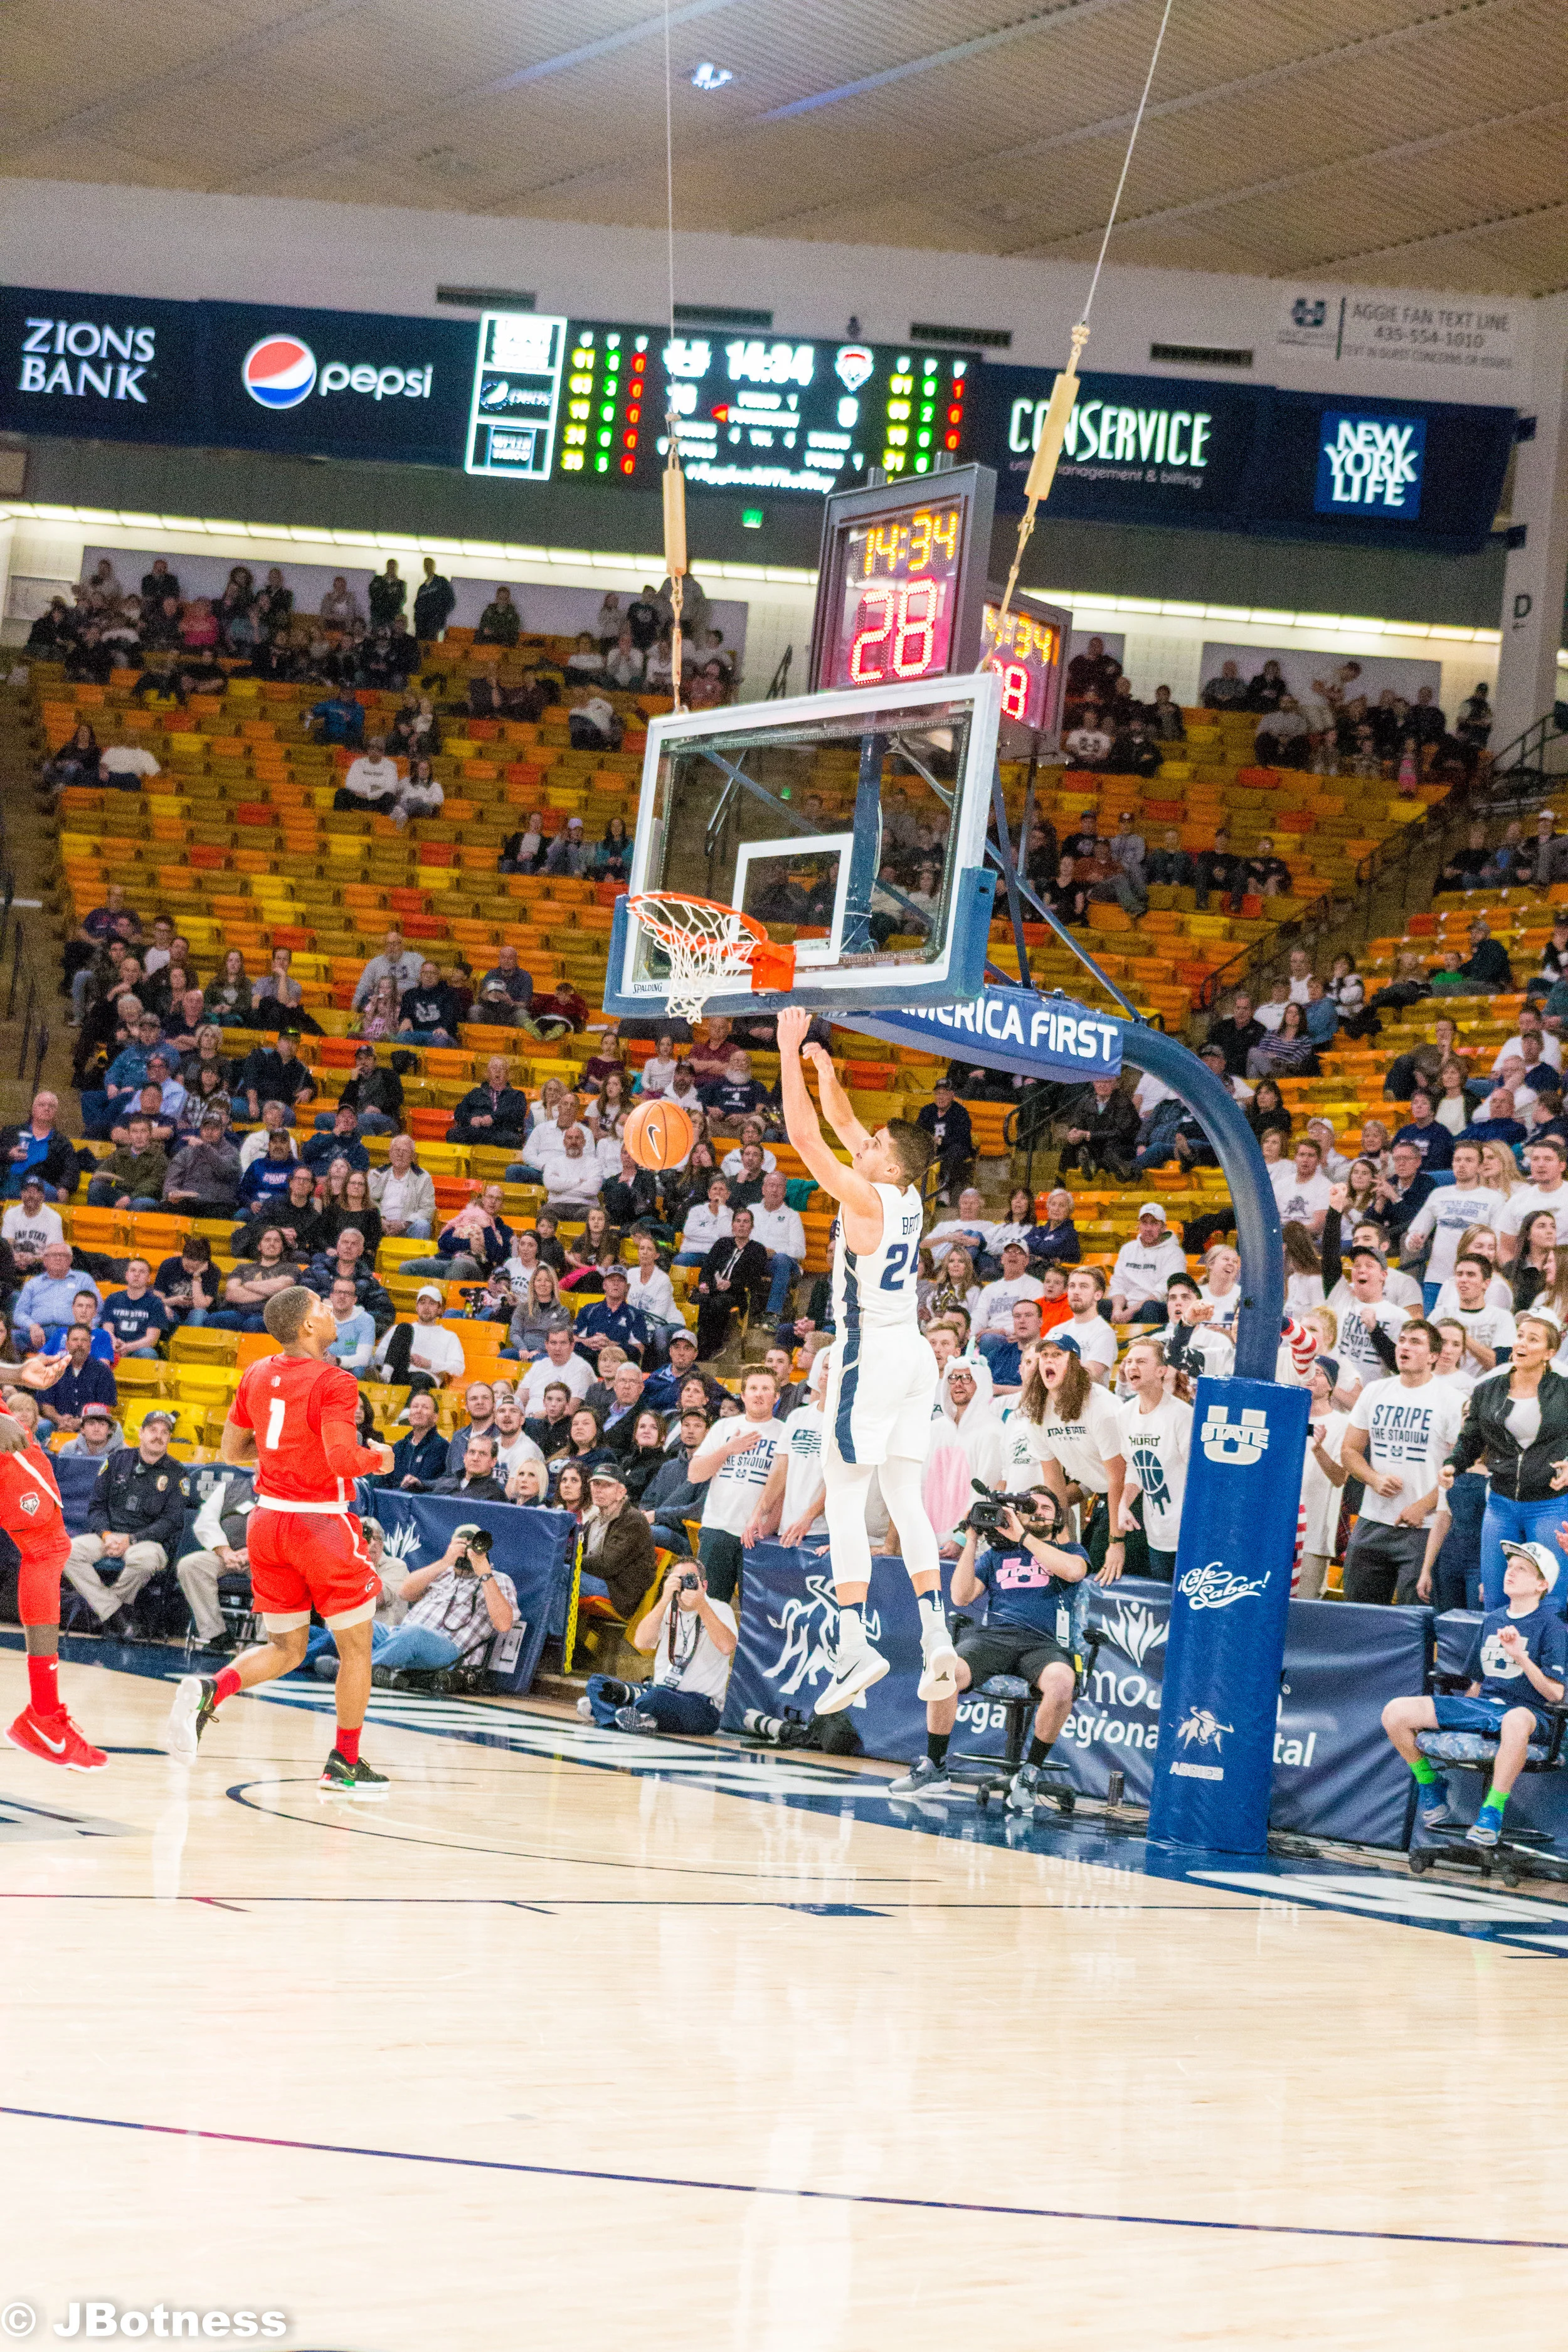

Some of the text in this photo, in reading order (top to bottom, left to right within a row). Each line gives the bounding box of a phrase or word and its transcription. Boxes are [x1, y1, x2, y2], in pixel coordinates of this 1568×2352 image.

[1353, 304, 1510, 332] AGGIE FAN TEXT LINE
[21, 317, 156, 363] ZIONS
[1374, 326, 1485, 349] 435-554-1010
[18, 354, 149, 404] BANK
[318, 361, 433, 400] pepsi
[1337, 419, 1414, 453] NEW
[1323, 442, 1419, 484] YORK
[1332, 474, 1406, 507] LIFE
[864, 509, 958, 576] 14:34
[1514, 593, 1532, 618] D
[849, 576, 939, 685] 28
[985, 607, 1054, 664] 4:34
[633, 982, 662, 994] SPALDING
[1030, 1011, 1118, 1061] FIRST
[266, 1398, 285, 1449] 1
[1065, 1426, 1088, 1435] STATE
[1373, 1404, 1433, 1431] STRIPE
[1129, 1435, 1160, 1447] HURD
[1200, 1422, 1269, 1449] STATE
[1372, 1428, 1429, 1445] THE STADIUM
[738, 1456, 773, 1471] STADIUM
[1189, 1571, 1271, 1610] Sabor!
[955, 1701, 1316, 1767] oga egiona tal
[1169, 1761, 1224, 1781] AGGIES
